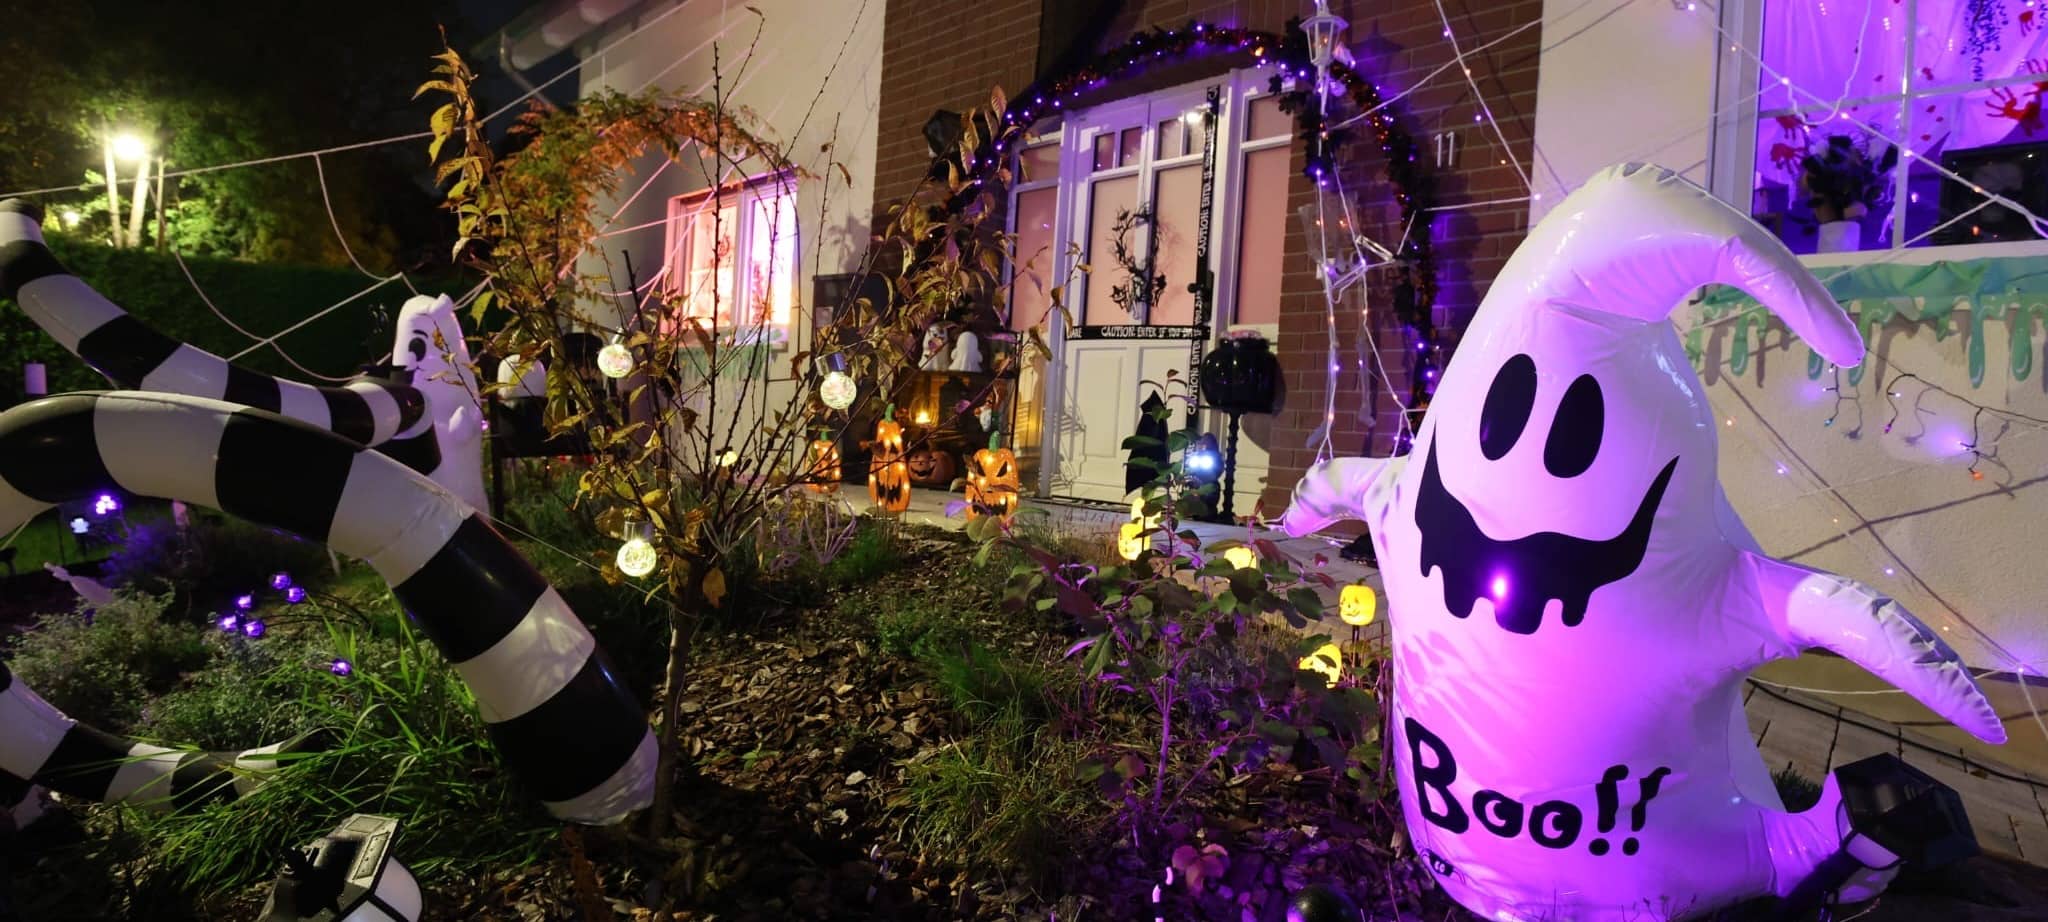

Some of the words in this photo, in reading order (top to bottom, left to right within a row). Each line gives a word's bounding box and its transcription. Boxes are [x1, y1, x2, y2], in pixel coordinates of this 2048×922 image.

[1434, 131, 1455, 168] 11
[1198, 209, 1209, 257] CAUTION:
[1101, 326, 1136, 338] CAUTION:
[1137, 327, 1157, 338] ENTER
[1159, 327, 1167, 338] IF
[1191, 340, 1201, 365] ENTER
[1187, 367, 1200, 415] CUTION:
[1405, 717, 1671, 856] Boo!!
